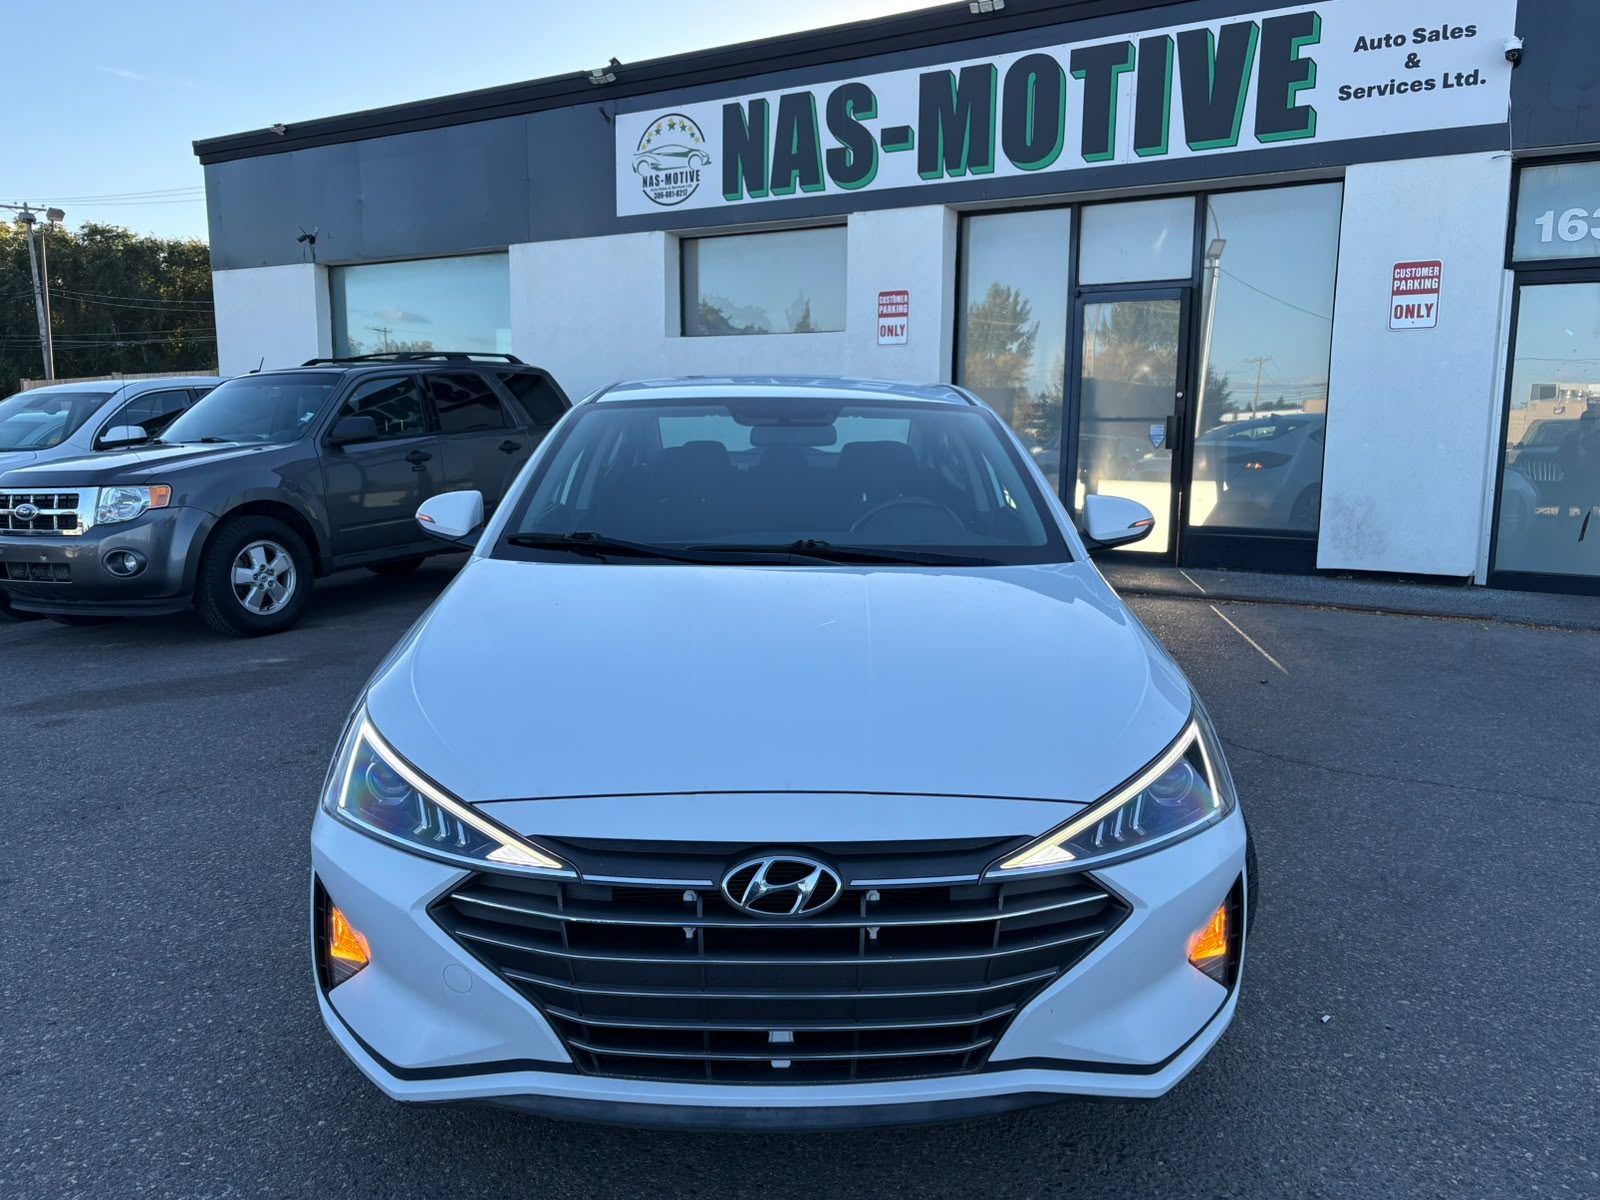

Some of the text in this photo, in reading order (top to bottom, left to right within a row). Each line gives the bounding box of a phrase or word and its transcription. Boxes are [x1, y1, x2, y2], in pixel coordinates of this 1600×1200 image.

[1353, 24, 1477, 53] Auto Sales
[1404, 52, 1421, 69] &
[1338, 69, 1487, 102] Services Ltd.
[721, 10, 1322, 201] NAS-MOTIVE
[642, 169, 700, 188] NAS-MOTIVE
[1394, 266, 1440, 279] CUSTOMER
[1393, 278, 1439, 291] PARKING
[879, 304, 908, 314] PARKING
[1393, 302, 1435, 319] ONLY
[880, 324, 906, 337] ONLY
